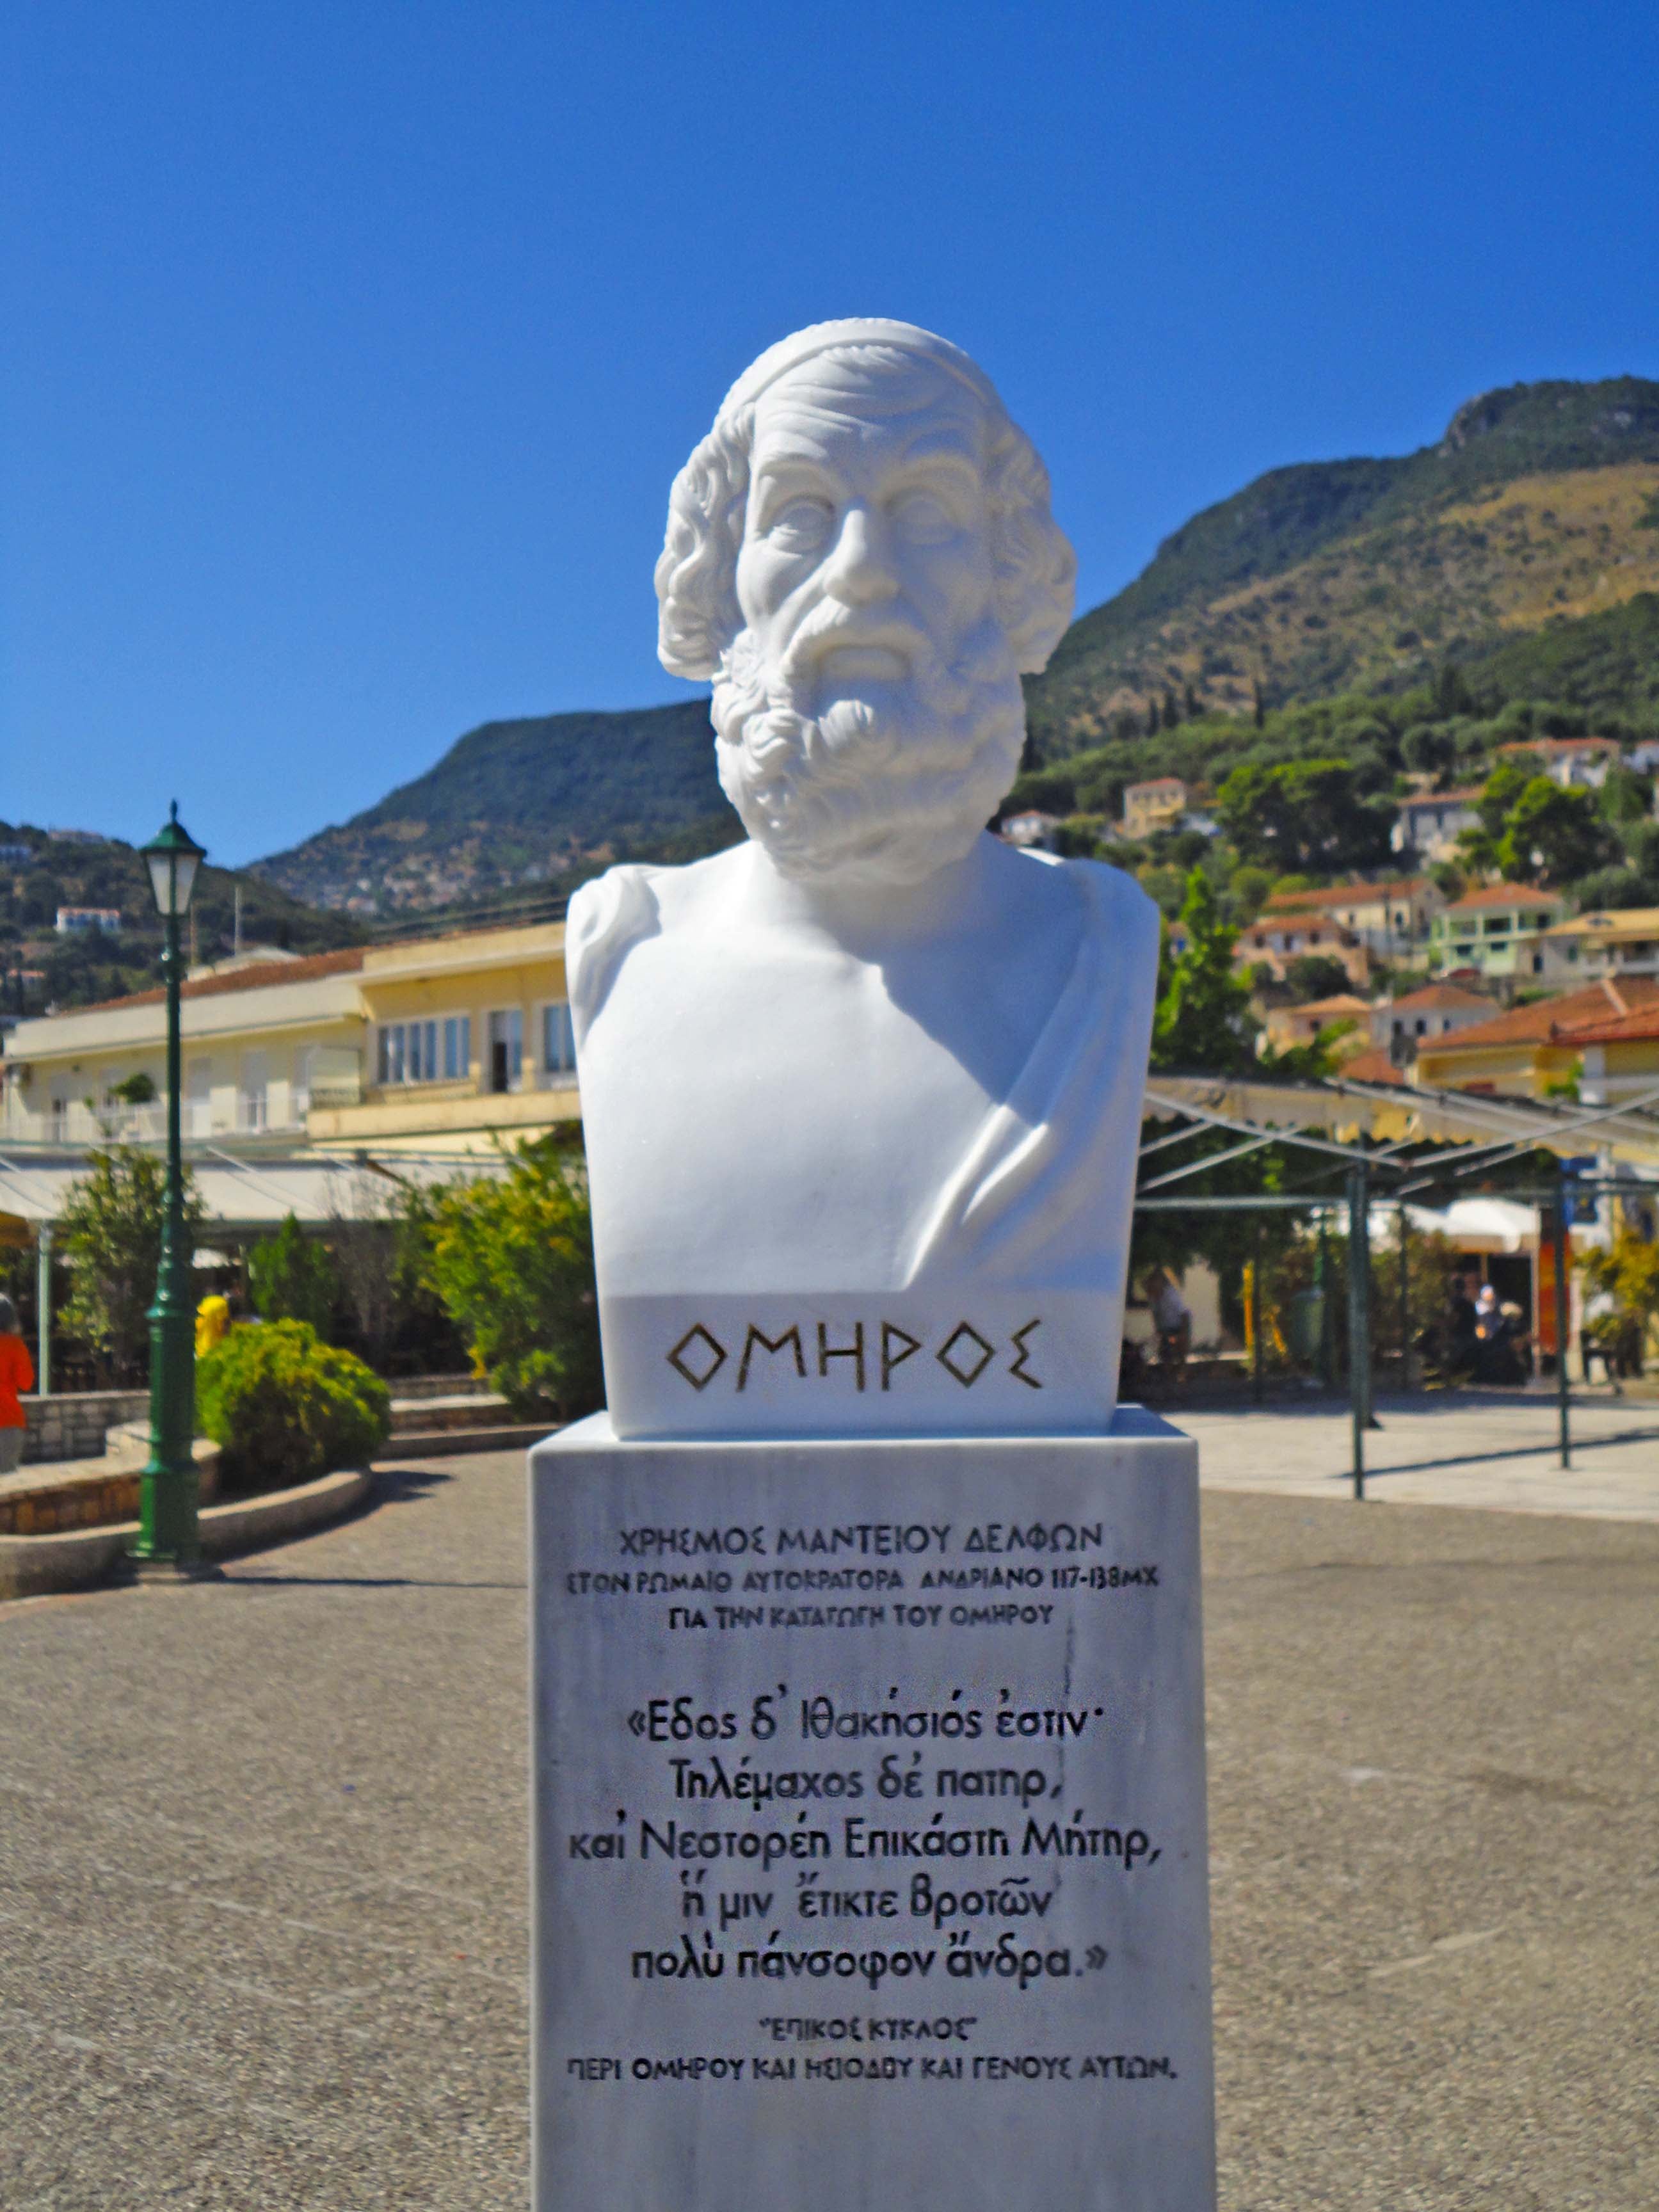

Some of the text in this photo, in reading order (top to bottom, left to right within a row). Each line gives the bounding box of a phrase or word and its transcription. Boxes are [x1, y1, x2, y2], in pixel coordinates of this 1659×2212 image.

[666, 1318, 1043, 1392] ΟΜΗΡΟΣ
[620, 1521, 1103, 1557] ΧΡΗΣΜΟΣ ΜΑΝΤΕΙΟΥ ΔΕΛΦΩΝ
[566, 1571, 630, 1595] ΣΤΟΝ
[634, 1571, 733, 1594] ΡΩΜΑΙΟ
[741, 1568, 906, 1594] ΑΥΤΟΚΡΑΤΟΡΑ
[918, 1566, 1045, 1590] ΑΝΔΡΙΑΝΟ
[668, 1603, 1055, 1630] ΓΙΑ ΤΗΝ ΚΑΤΑΓΩΓΗ ΤΟΥ ΟΜΗΡΟΥ
[668, 1755, 865, 1812] Τηλέμαχος
[639, 1810, 832, 1873] Νεστορέη
[844, 1812, 1011, 1859] Επικάστη
[719, 1892, 774, 1932] μιν
[737, 1930, 936, 1991] πάνσοφον
[567, 2057, 622, 2081] ΠΕΡΙ
[631, 2056, 746, 2080] ΟΜΗΡΟΥ
[752, 2056, 797, 2080] ΚΑΙ
[805, 2056, 914, 2080] ΗΣΙΟΔΟΥ
[920, 2055, 964, 2080] ΚΑΙ
[972, 2054, 1073, 2081] ΓΕΝΟΥΣ
